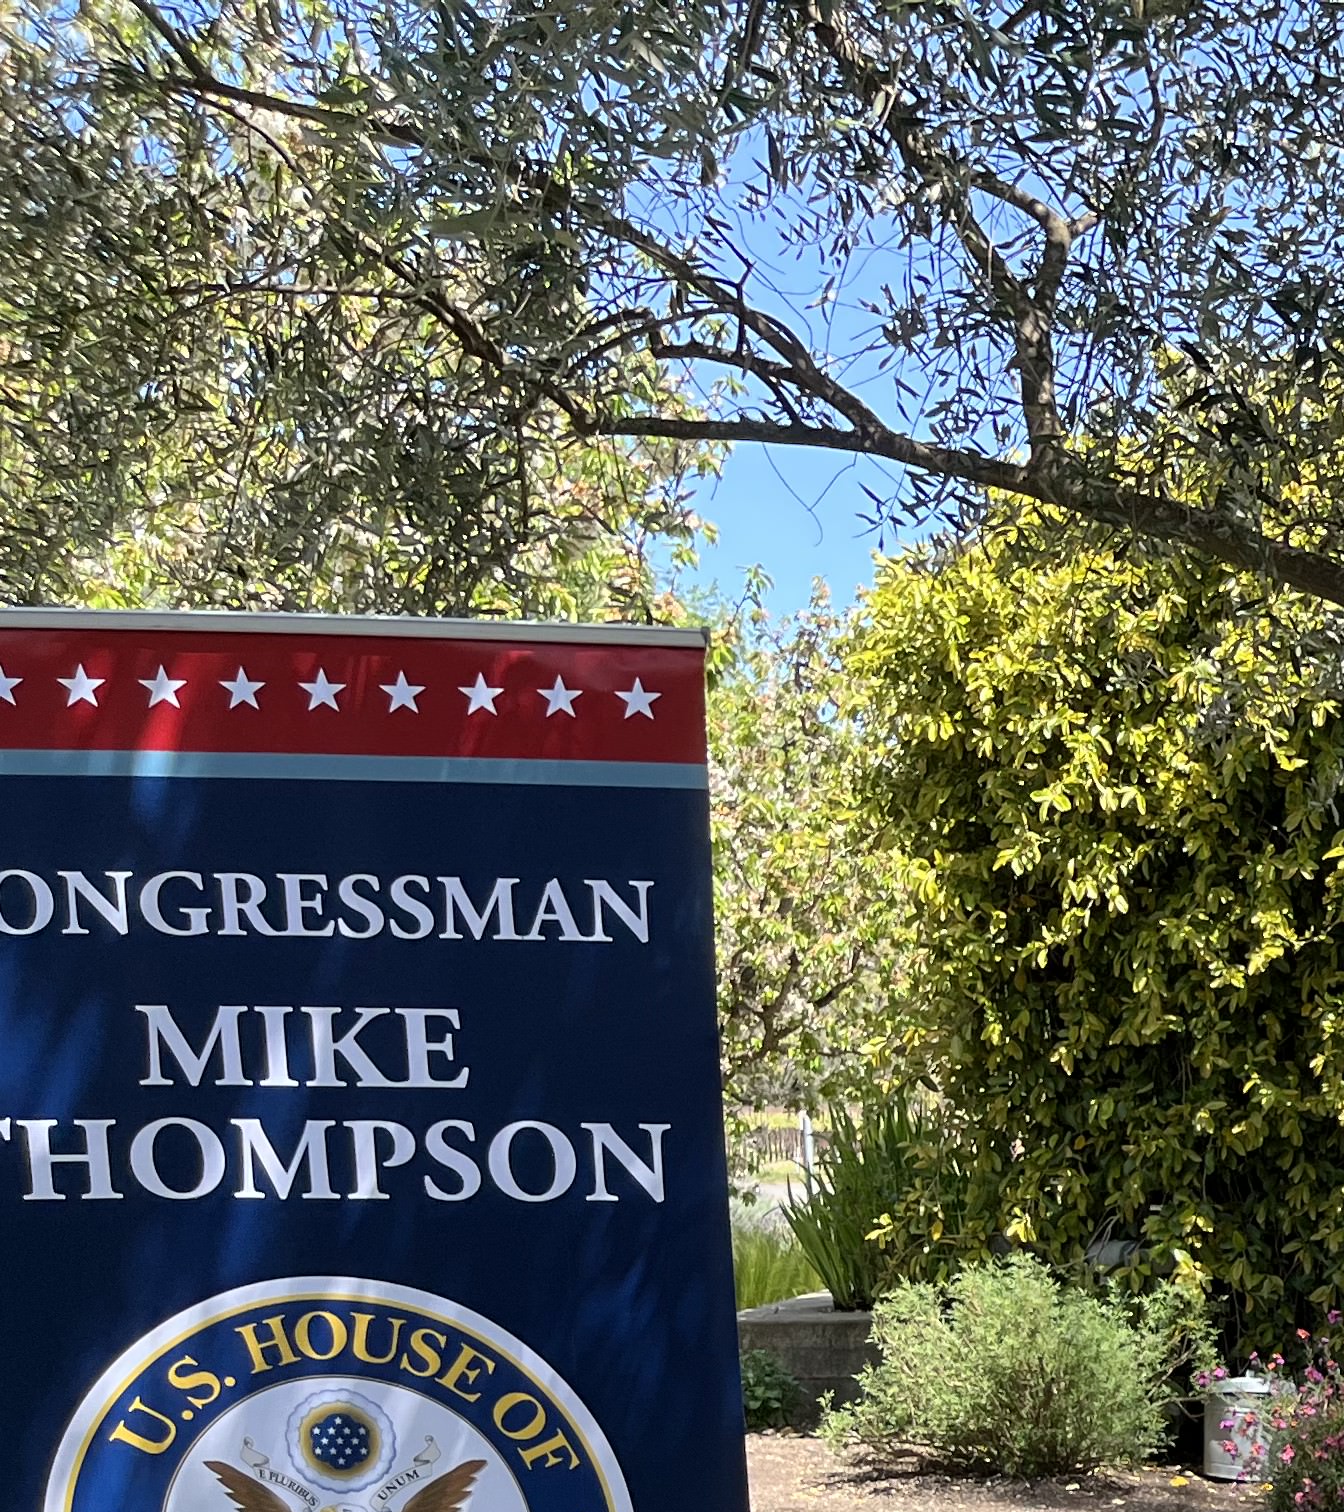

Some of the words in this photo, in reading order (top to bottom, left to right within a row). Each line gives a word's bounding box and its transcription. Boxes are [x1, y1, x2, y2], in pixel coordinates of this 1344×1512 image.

[0, 869, 655, 943] ONGRESSMAN
[135, 1004, 470, 1090] MIKE
[0, 1116, 671, 1203] HOMPSON
[109, 1354, 236, 1455] U.S.
[234, 1310, 496, 1403] HOUSE
[492, 1391, 582, 1472] OF
[269, 1471, 319, 1507] PLURIBUS
[377, 1469, 420, 1501] UNUM
